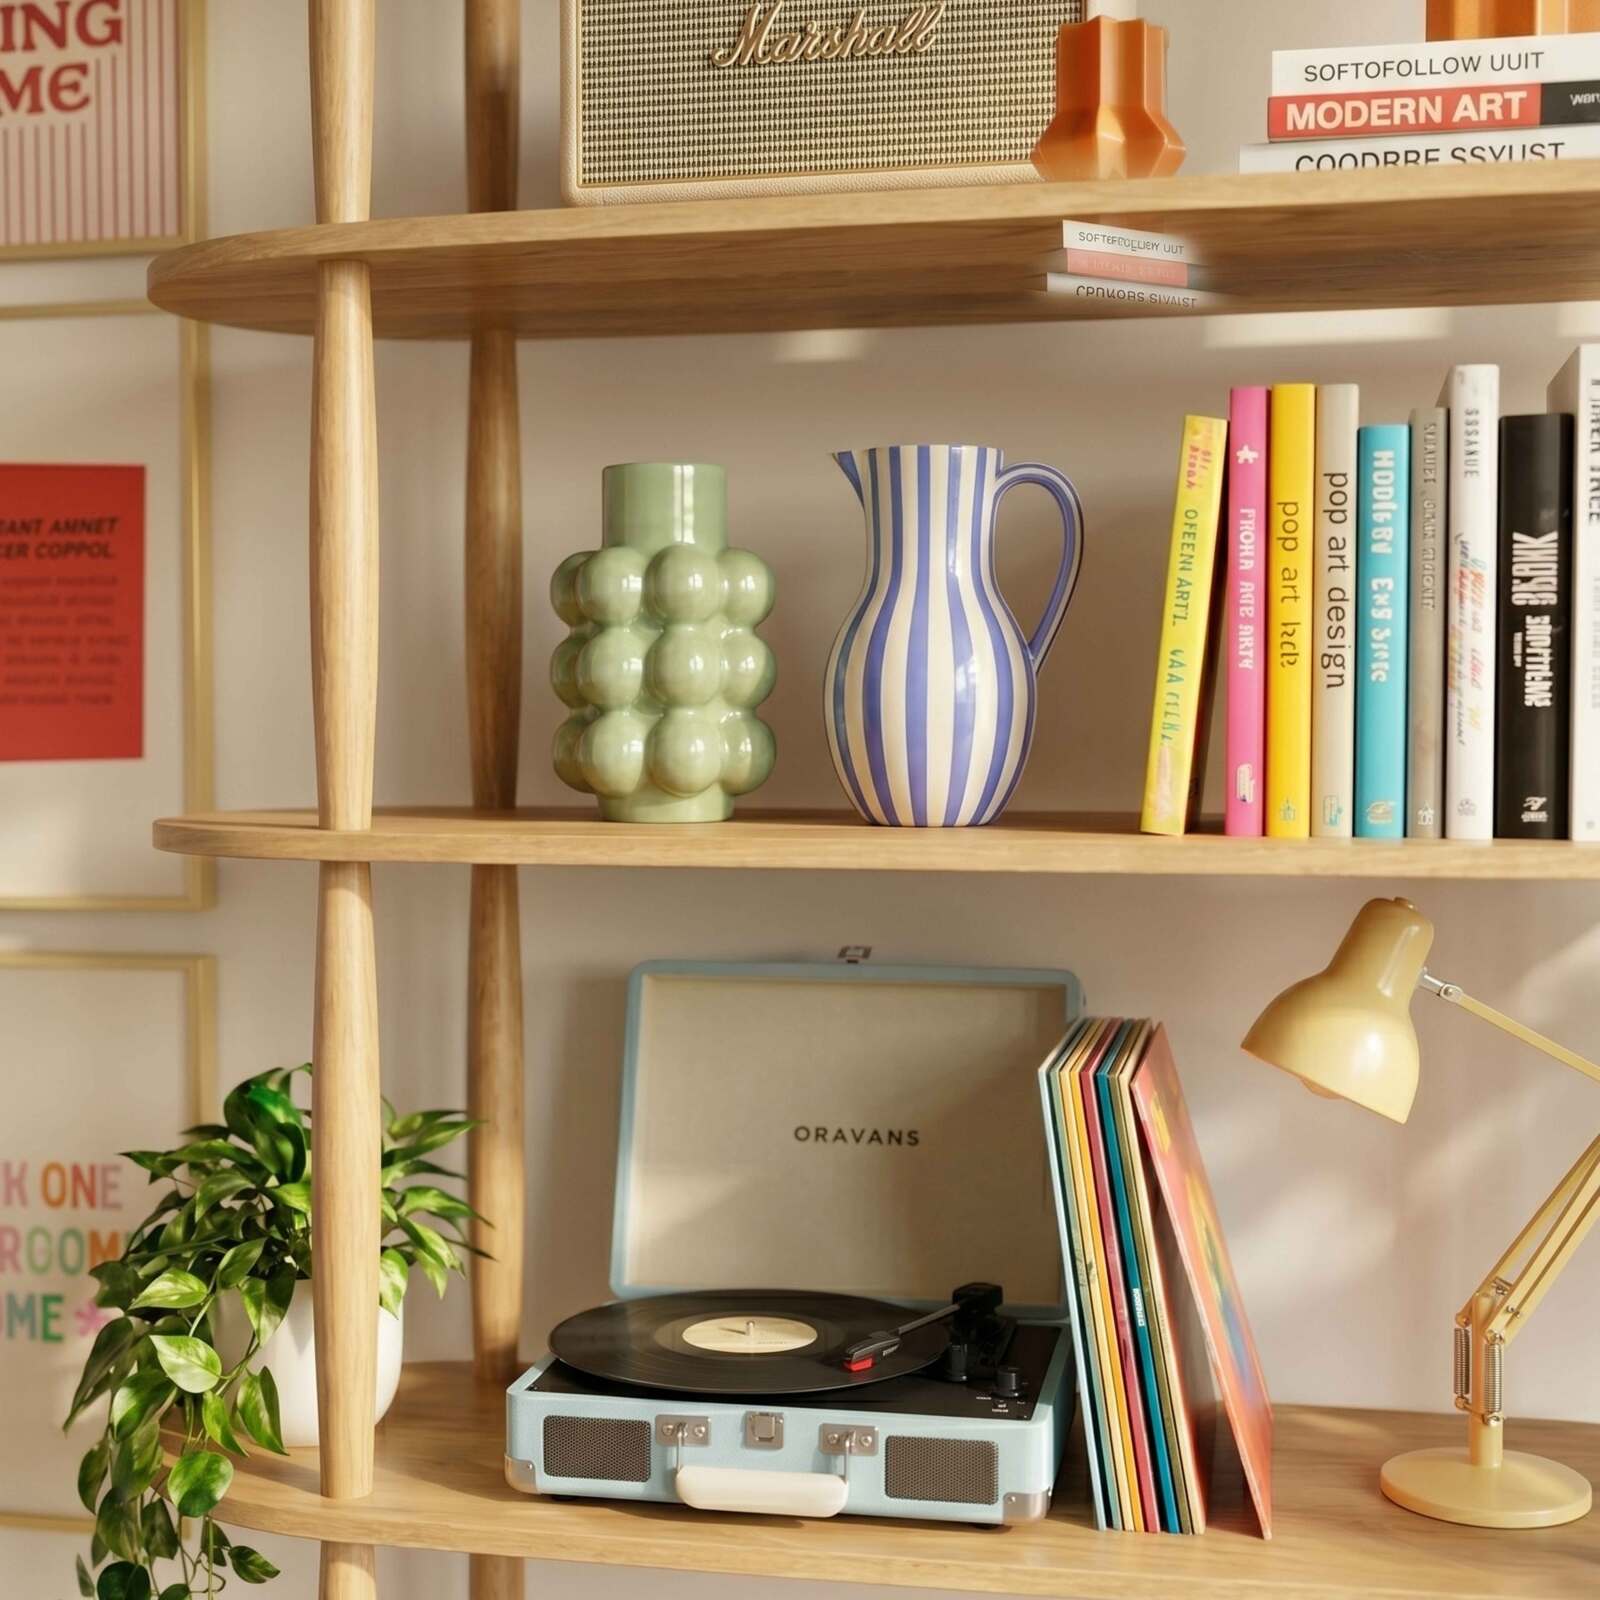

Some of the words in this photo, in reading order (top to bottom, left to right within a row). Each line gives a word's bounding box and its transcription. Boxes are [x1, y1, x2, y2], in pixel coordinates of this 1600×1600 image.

[0, 0, 122, 52] ING
[711, 0, 947, 67] Marshall
[1304, 55, 1482, 82] SOFTOFOLLOW
[1490, 51, 1545, 72] UUIT
[1286, 93, 1443, 131] MODERN
[1452, 90, 1528, 122] ART
[1323, 472, 1348, 525] pop
[1277, 501, 1299, 552] pop
[1327, 536, 1351, 573] art
[1280, 567, 1301, 603] art
[1321, 587, 1351, 689] design
[794, 1125, 920, 1147] ORAVANS
[41, 1161, 123, 1210] ONE
[0, 1290, 64, 1343] ME
